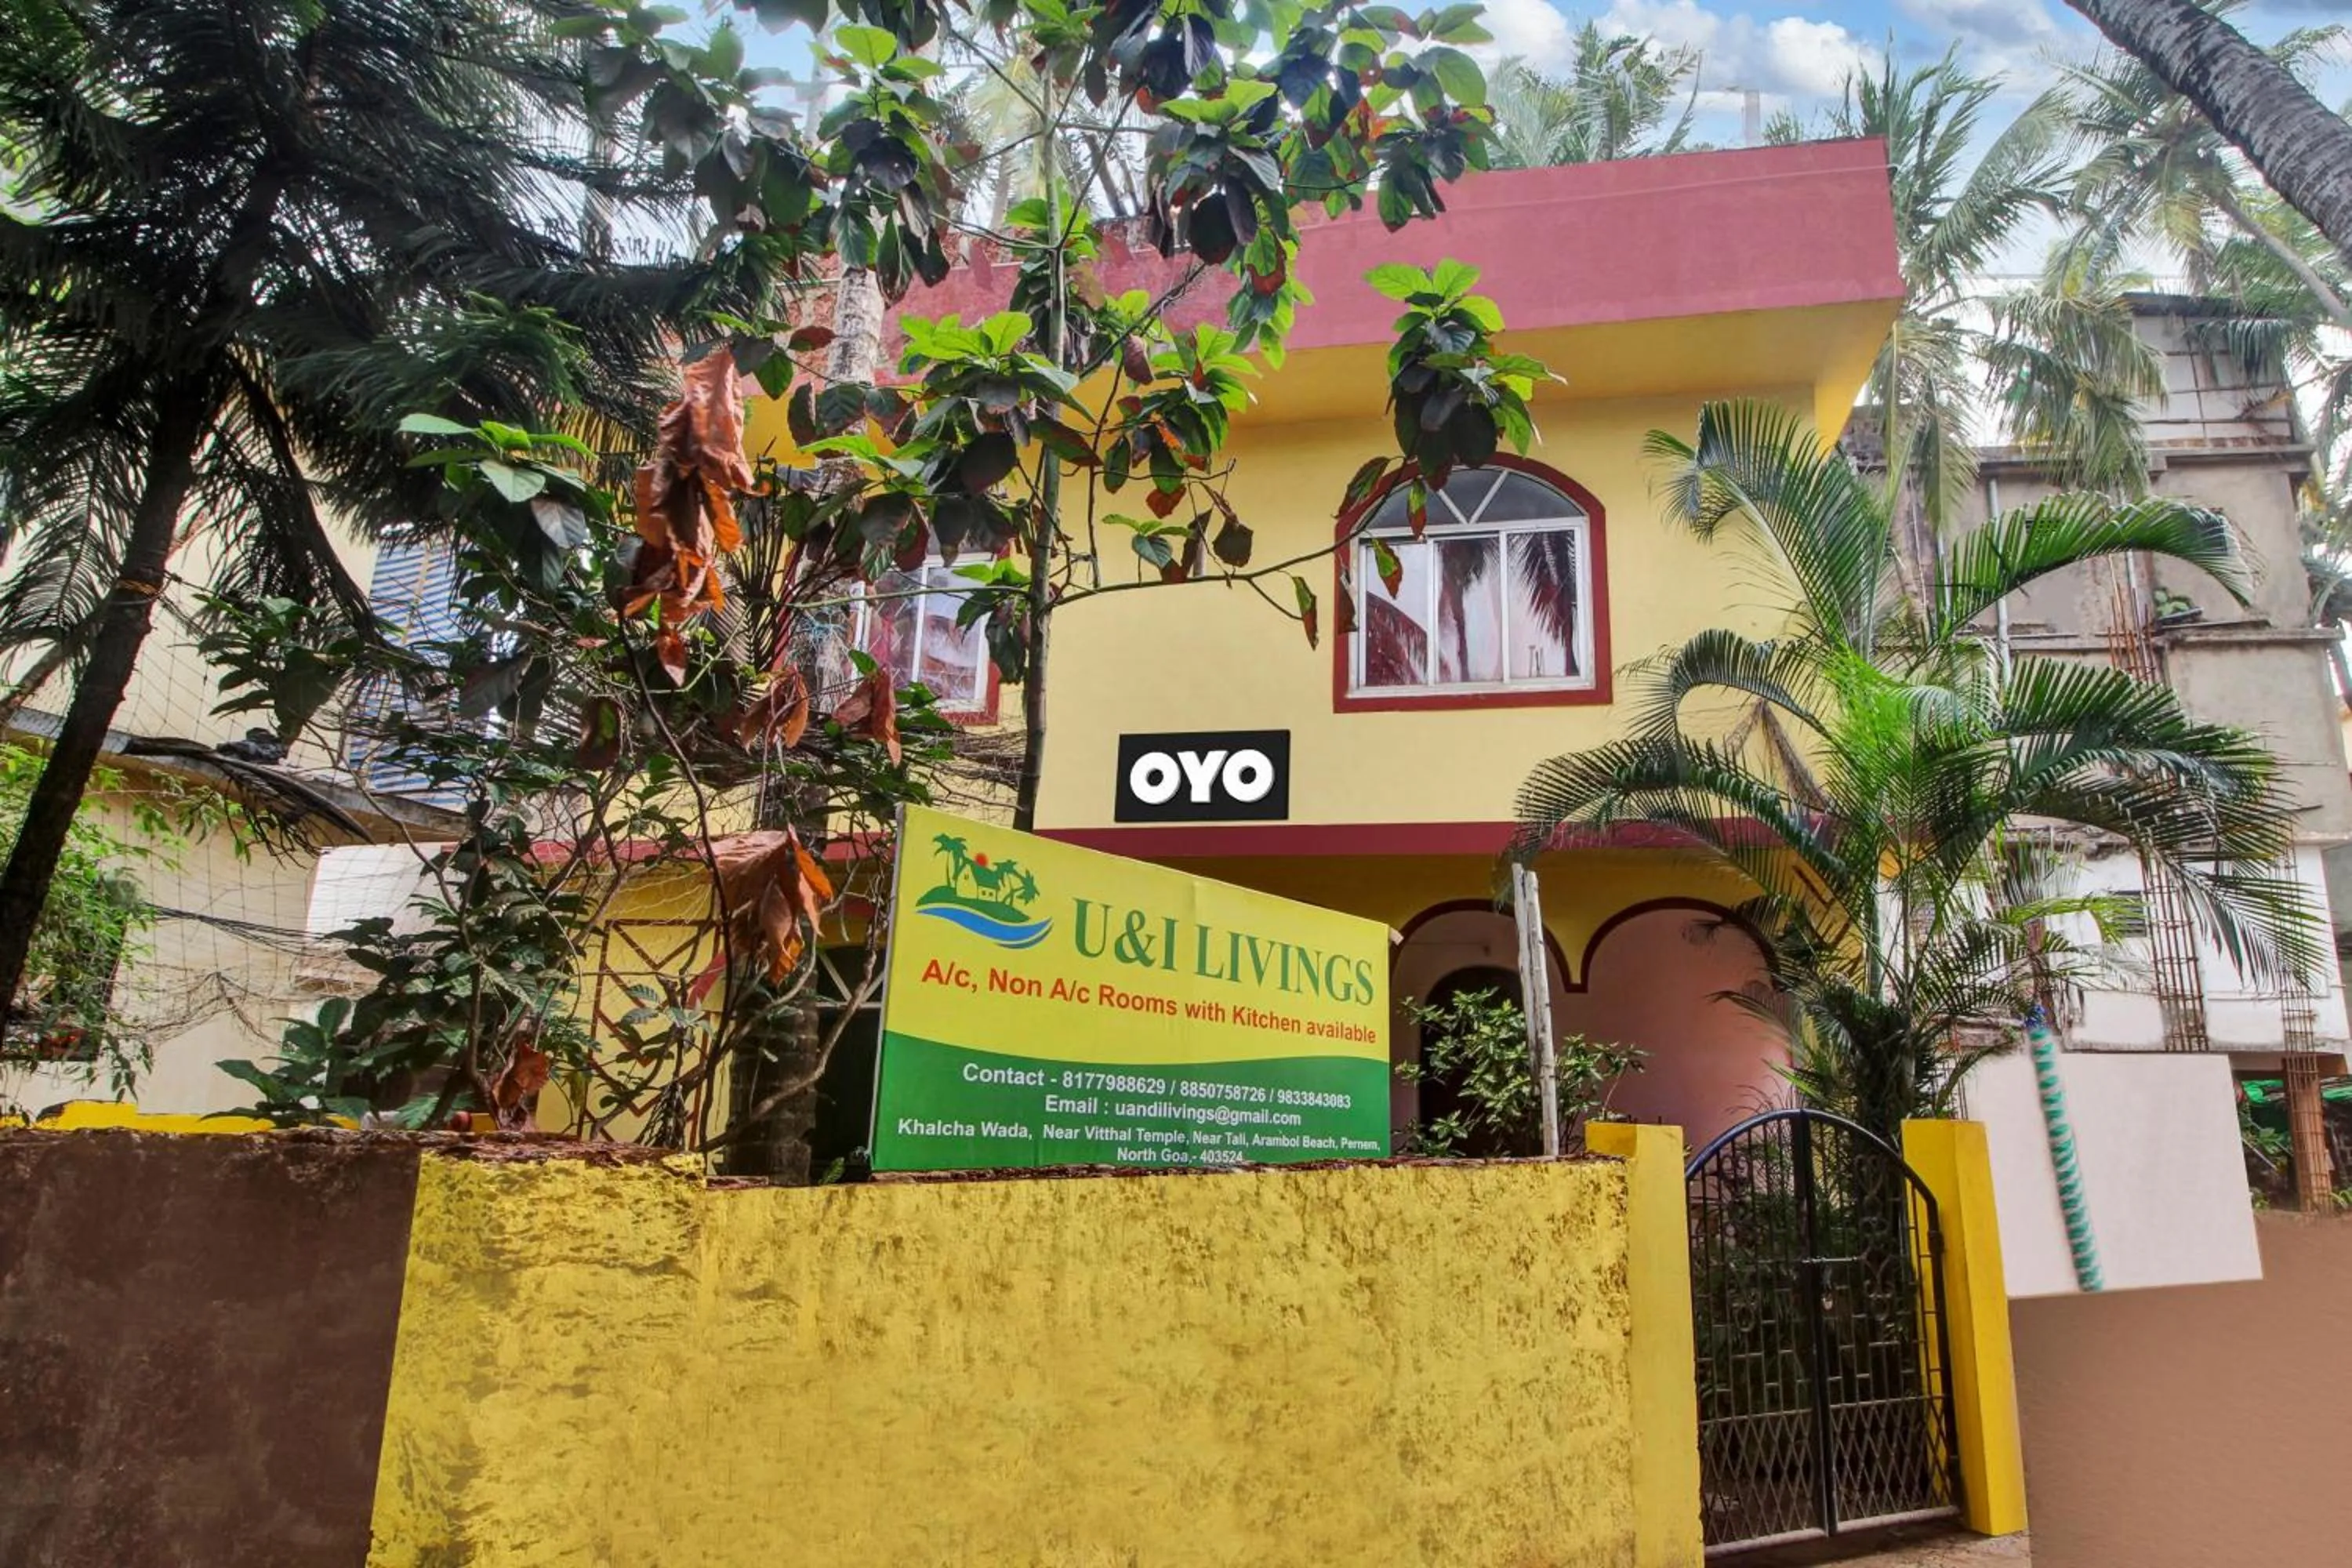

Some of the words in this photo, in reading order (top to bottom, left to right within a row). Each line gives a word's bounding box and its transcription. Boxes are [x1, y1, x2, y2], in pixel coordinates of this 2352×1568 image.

[1130, 749, 1275, 805] OYO
[1073, 898, 1178, 972] U&I
[1194, 924, 1374, 1006] LIVINGS
[921, 959, 978, 994] A/c,
[989, 967, 1041, 997] Non
[1050, 978, 1090, 1004] A/c
[1098, 984, 1178, 1015] Rooms
[1185, 1000, 1225, 1023] with
[1232, 1005, 1301, 1033] Kitchen
[1307, 1020, 1376, 1044] available
[963, 1063, 1044, 1086] Contact
[1062, 1071, 1166, 1094] 8177988629
[1180, 1080, 1266, 1102] 8850758726
[1045, 1094, 1098, 1114] Email
[1116, 1101, 1301, 1126] uandilivings@gmail.com
[898, 1119, 975, 1136] Khalcha
[981, 1121, 1033, 1141] Wada,
[1043, 1123, 1080, 1139] Near
[1084, 1125, 1131, 1142] Vitthal
[1135, 1127, 1189, 1145] Temple,
[1192, 1131, 1221, 1145] Near
[1252, 1133, 1299, 1148] Arambol
[1302, 1136, 1338, 1150] Beach,
[1341, 1138, 1381, 1152] Pernem,
[1117, 1147, 1156, 1161] North
